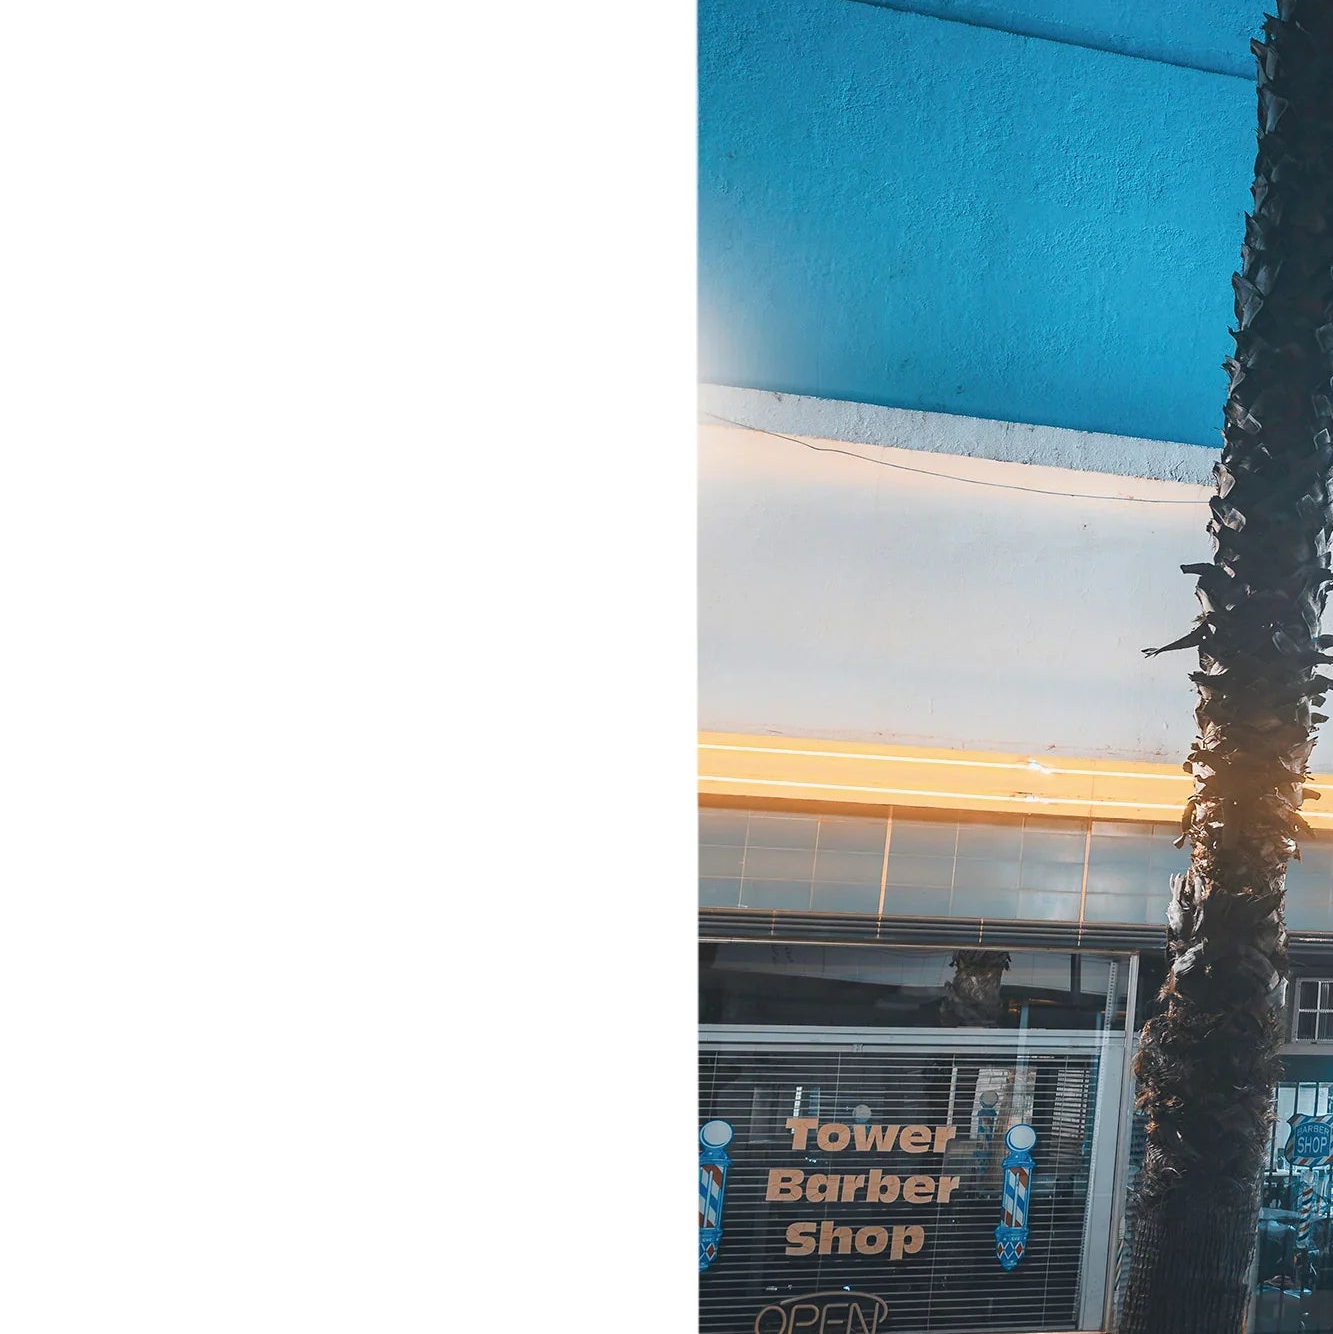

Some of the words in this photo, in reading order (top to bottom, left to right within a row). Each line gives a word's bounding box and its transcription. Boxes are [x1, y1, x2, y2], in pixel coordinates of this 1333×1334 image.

[785, 1118, 957, 1154] Tower
[1296, 1124, 1330, 1136] BARBER
[1297, 1136, 1328, 1153] SHOP
[765, 1169, 960, 1204] Barber
[785, 1220, 925, 1260] Shop
